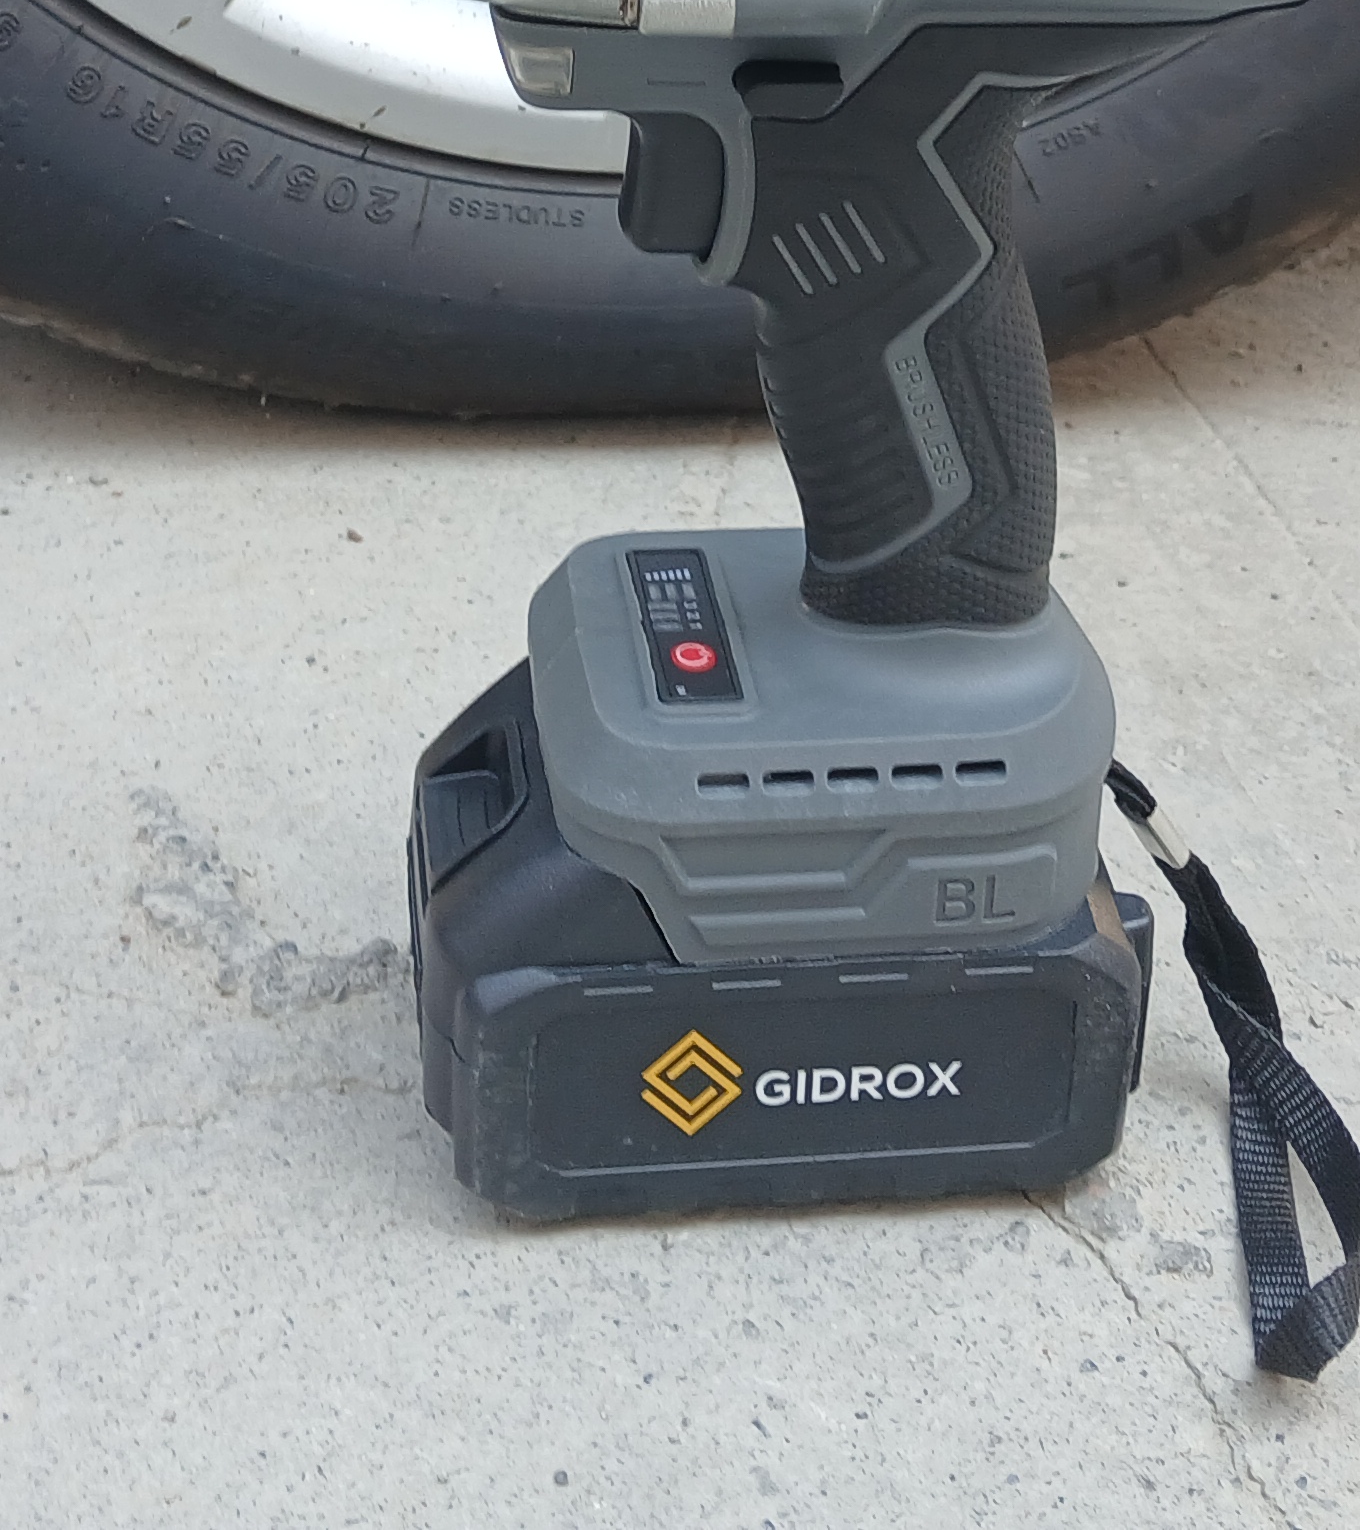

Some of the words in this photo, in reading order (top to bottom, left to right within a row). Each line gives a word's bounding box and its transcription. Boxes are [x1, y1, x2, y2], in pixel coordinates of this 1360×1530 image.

[65, 64, 401, 227] 205/55R16
[446, 195, 586, 229] STUDLESS
[894, 355, 959, 486] BRUSHLESS
[934, 875, 1016, 926] BL
[755, 1060, 963, 1109] GIDROX
